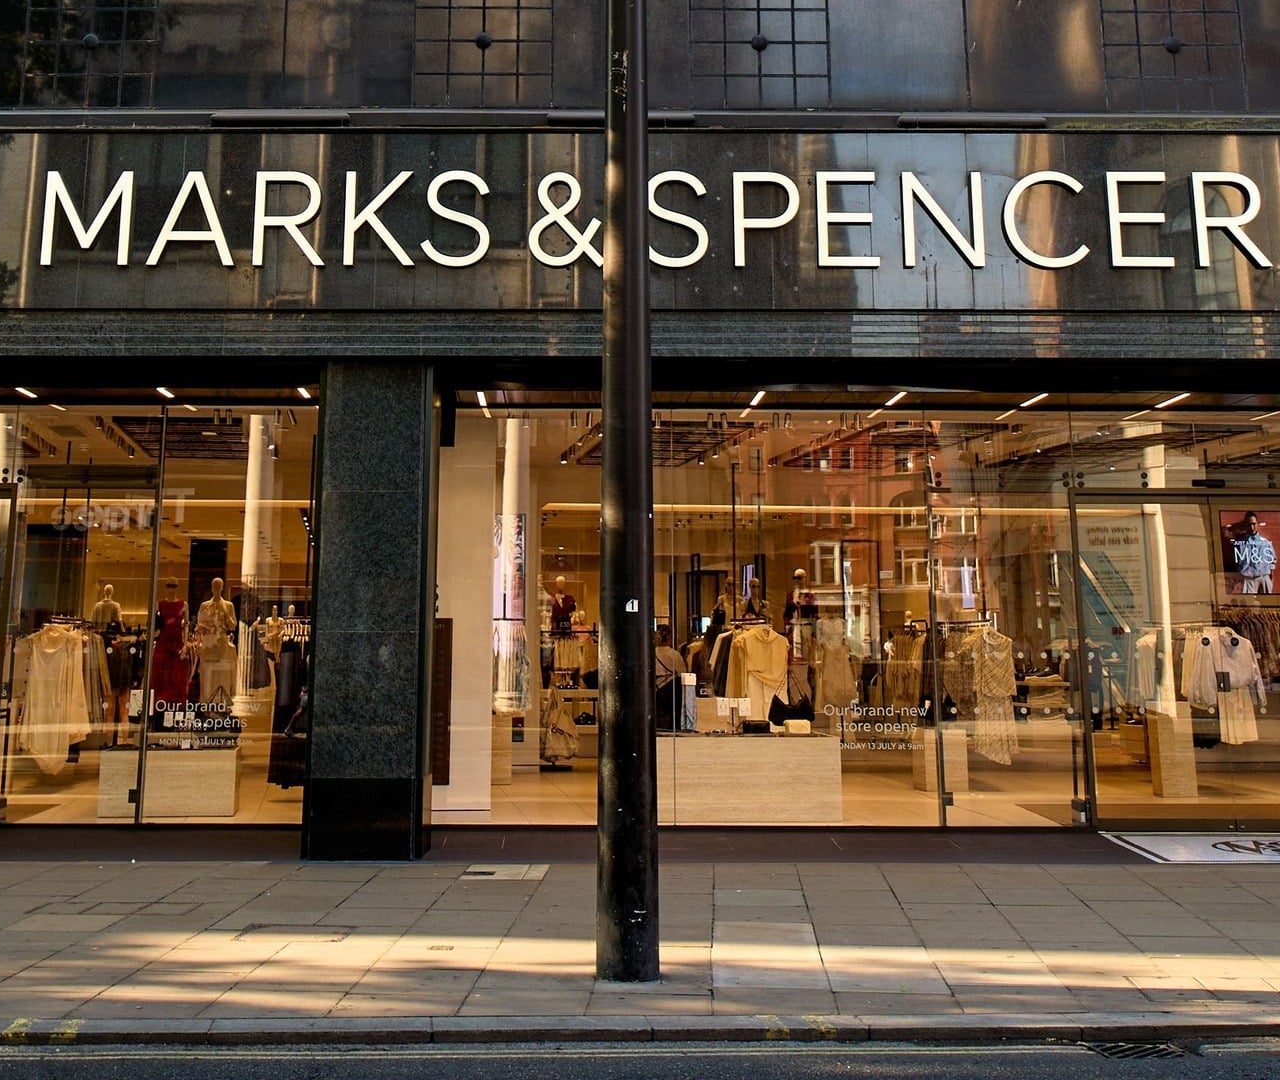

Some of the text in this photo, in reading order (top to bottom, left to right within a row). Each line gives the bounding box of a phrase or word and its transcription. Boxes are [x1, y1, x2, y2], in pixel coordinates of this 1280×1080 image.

[38, 168, 1273, 270] MARKS & SPENCER
[1233, 546, 1275, 564] M&S
[155, 699, 182, 712] Our
[823, 703, 928, 716] Our brand-new
[205, 717, 248, 731] opens
[836, 720, 917, 735] store opens
[877, 742, 896, 750] JULY
